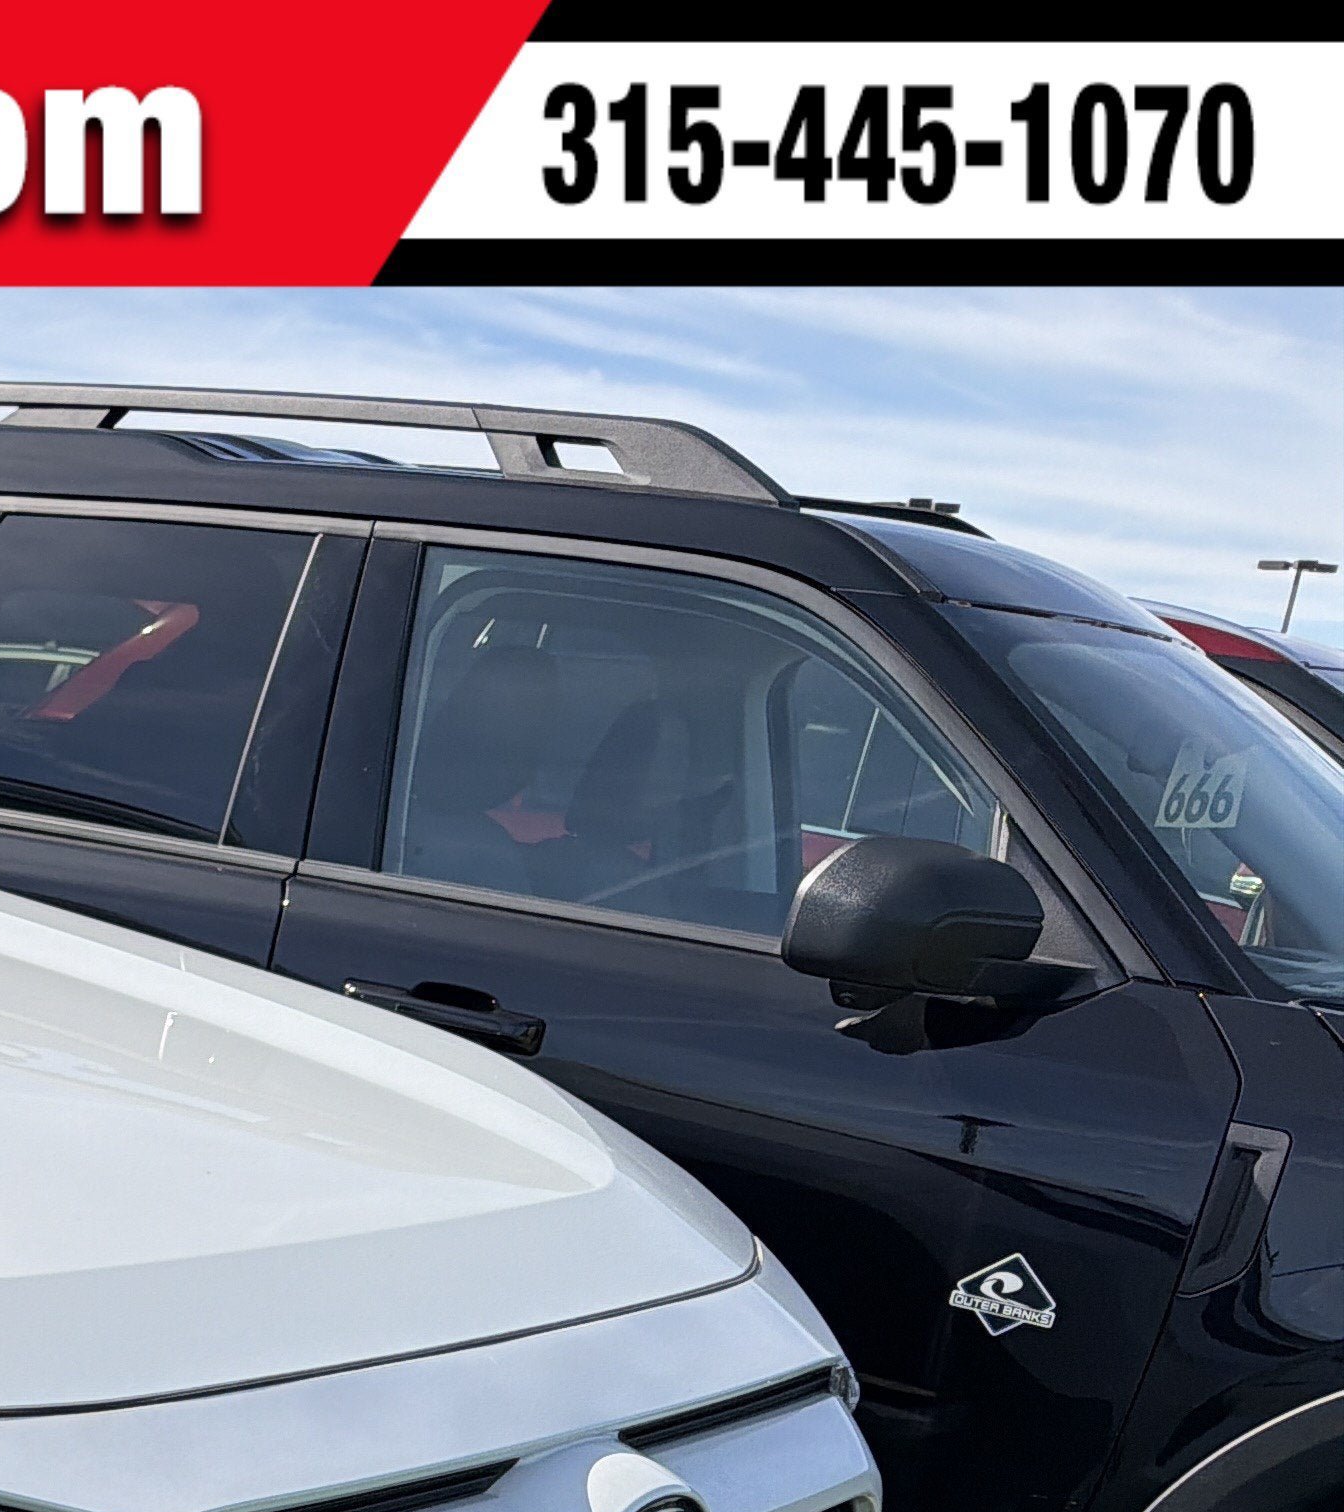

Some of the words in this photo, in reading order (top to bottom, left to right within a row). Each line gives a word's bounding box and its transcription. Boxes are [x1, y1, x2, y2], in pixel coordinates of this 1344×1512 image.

[1163, 773, 1235, 824] 666
[954, 1294, 1000, 1314] OUTER
[1002, 1305, 1051, 1326] BANKS
